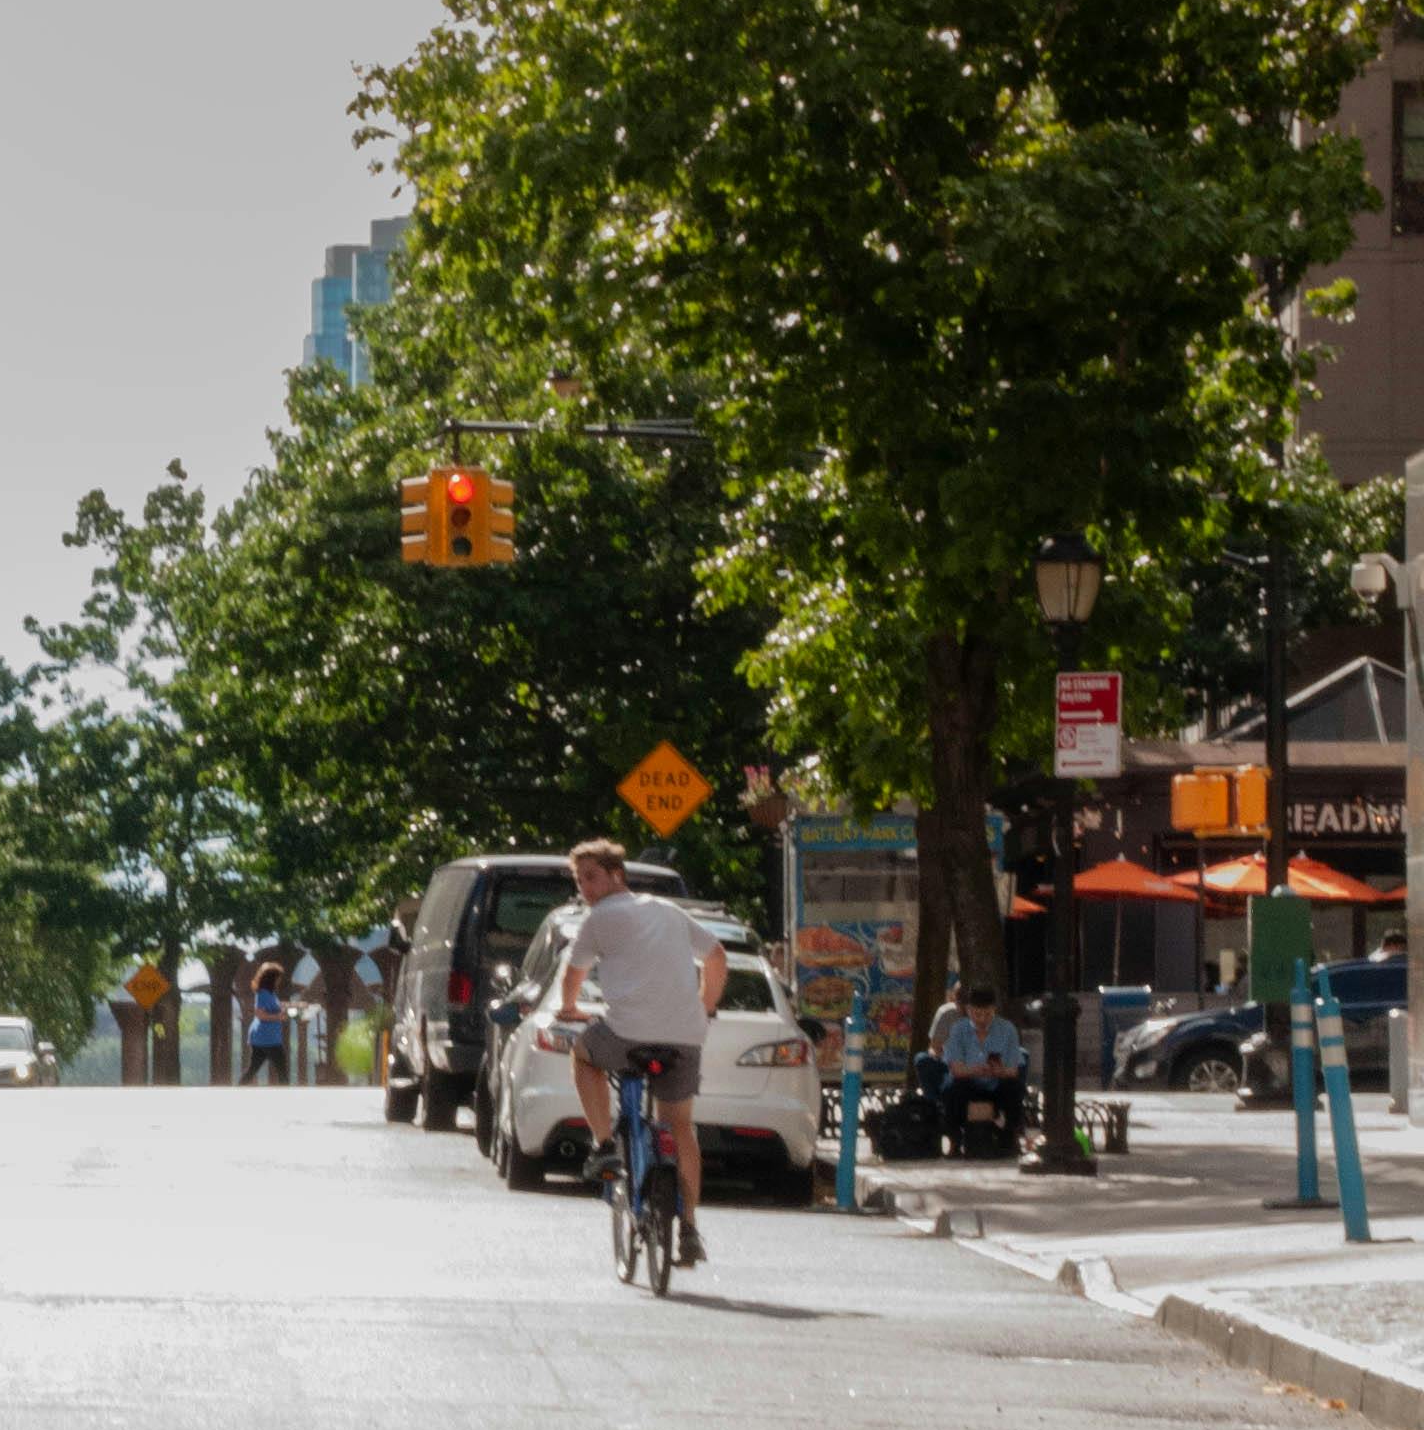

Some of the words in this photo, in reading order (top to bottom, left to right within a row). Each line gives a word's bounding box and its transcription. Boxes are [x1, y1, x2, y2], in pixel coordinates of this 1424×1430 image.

[1073, 678, 1111, 690] STANDING
[639, 772, 690, 788] DEAD
[647, 794, 683, 811] END
[801, 825, 859, 843] BATTERY
[862, 825, 897, 842] PARK
